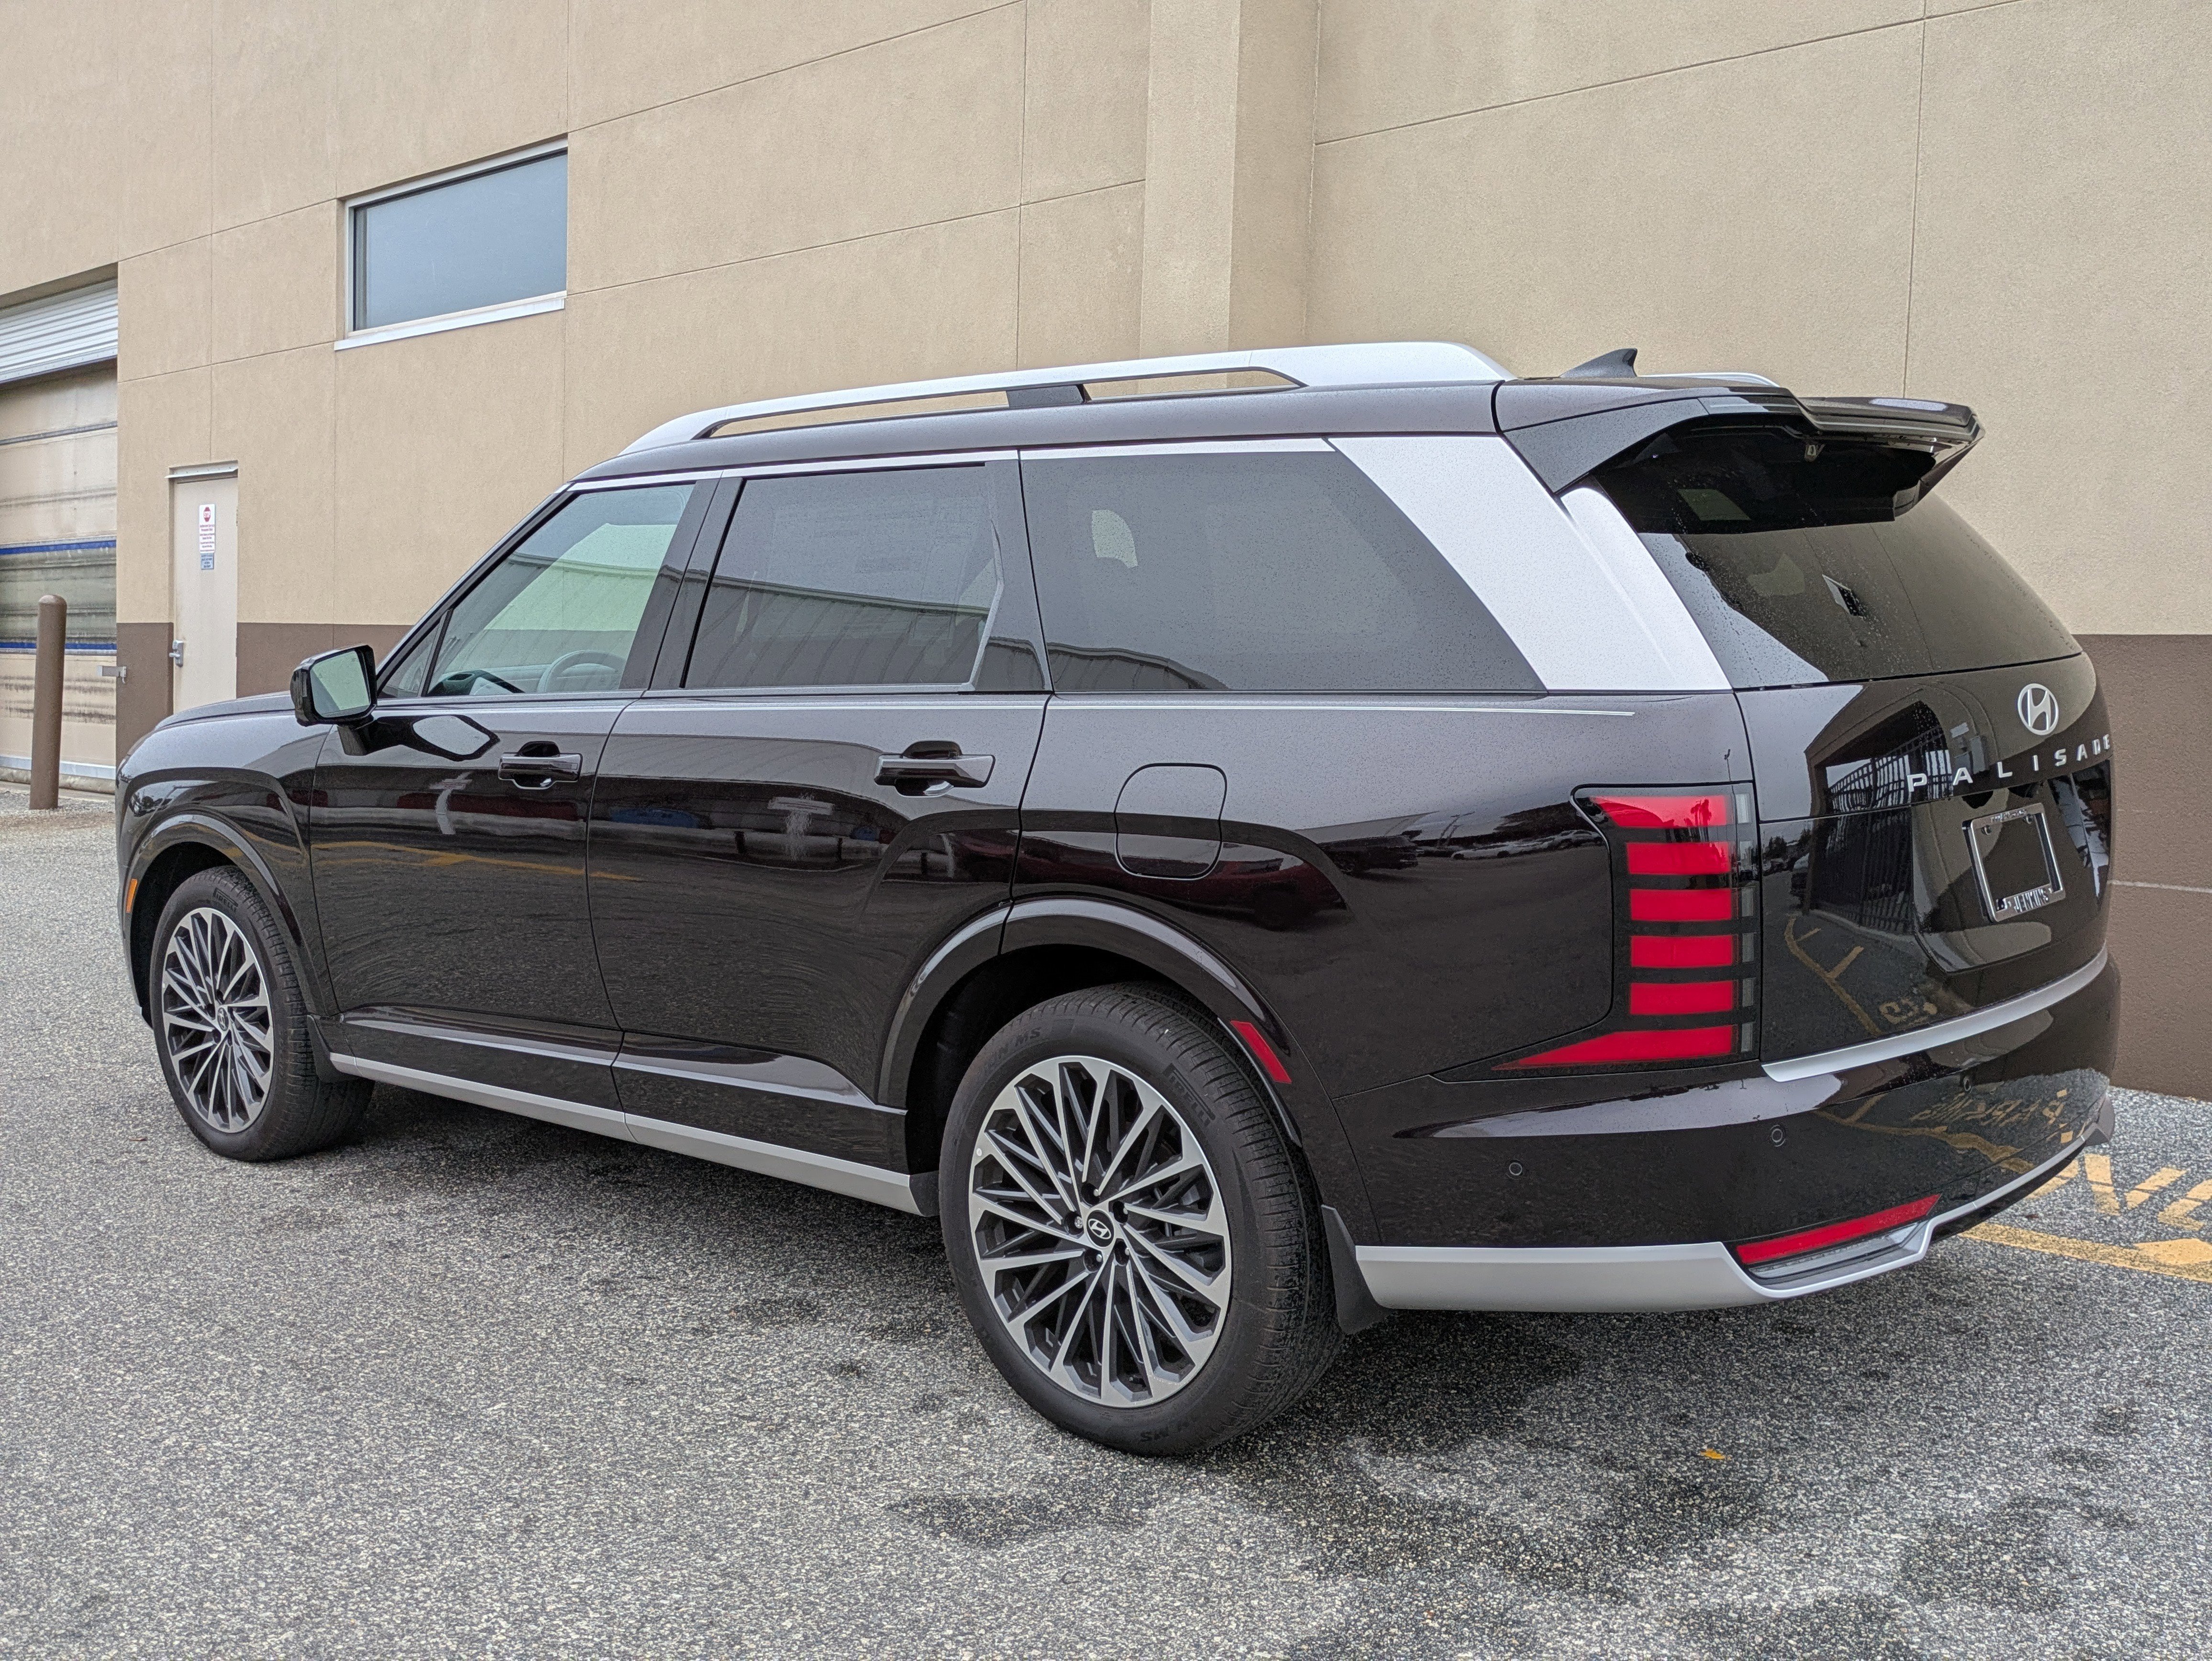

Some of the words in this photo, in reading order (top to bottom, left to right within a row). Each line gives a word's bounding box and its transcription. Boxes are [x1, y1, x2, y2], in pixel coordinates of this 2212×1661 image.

[1907, 734, 2111, 792] PALISADE
[212, 887, 239, 913] PIRELLI
[2013, 888, 2049, 913] JENKINS
[1161, 1063, 1216, 1127] PIRELLI
